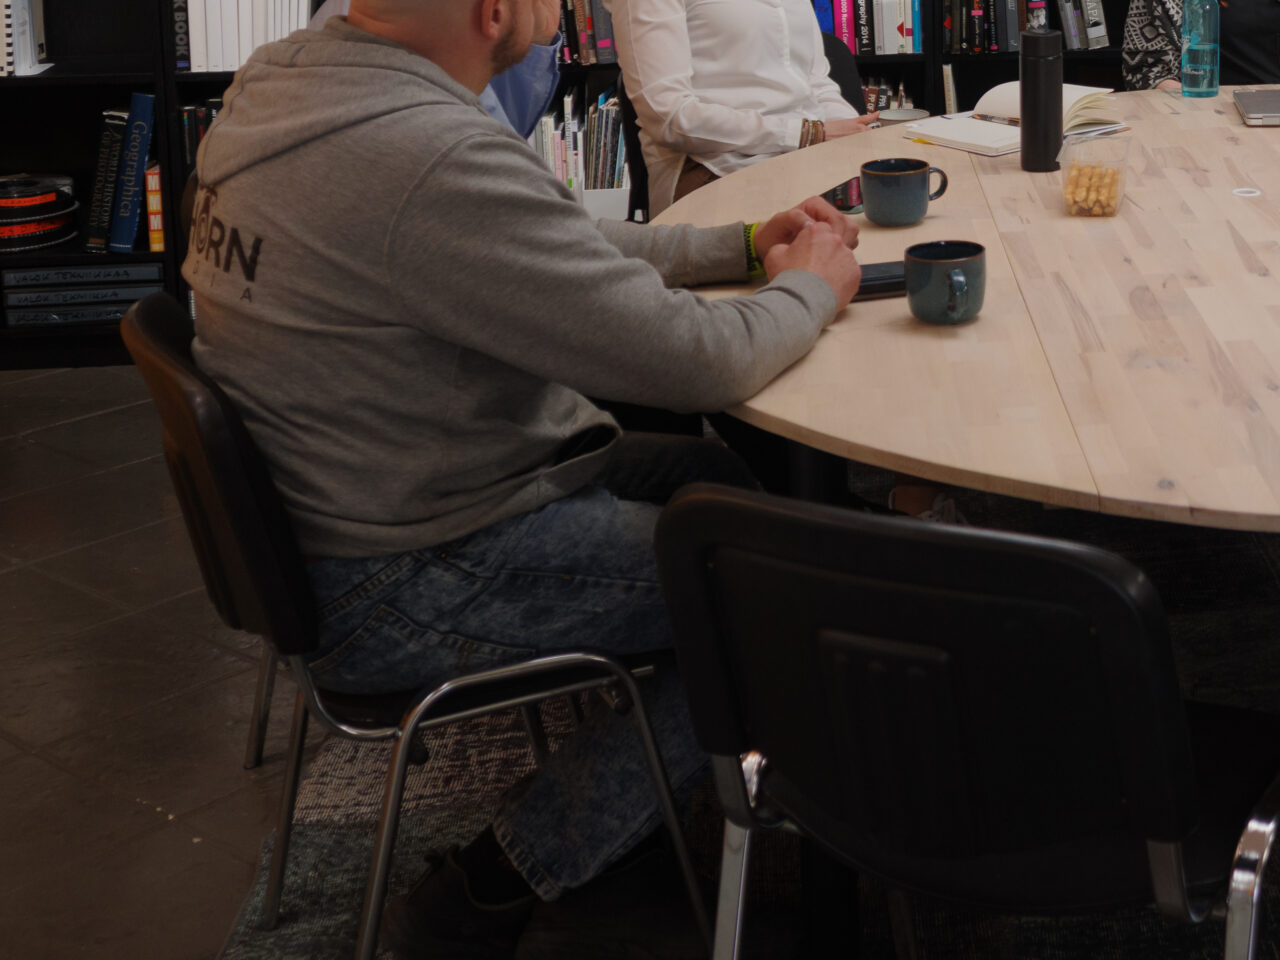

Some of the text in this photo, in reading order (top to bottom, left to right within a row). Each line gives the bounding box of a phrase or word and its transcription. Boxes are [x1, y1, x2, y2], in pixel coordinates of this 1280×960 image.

[88, 148, 109, 228] PHOTOGRAPHY
[107, 141, 120, 181] WORLD
[118, 120, 146, 217] Geographica
[99, 183, 115, 229] HISTORY
